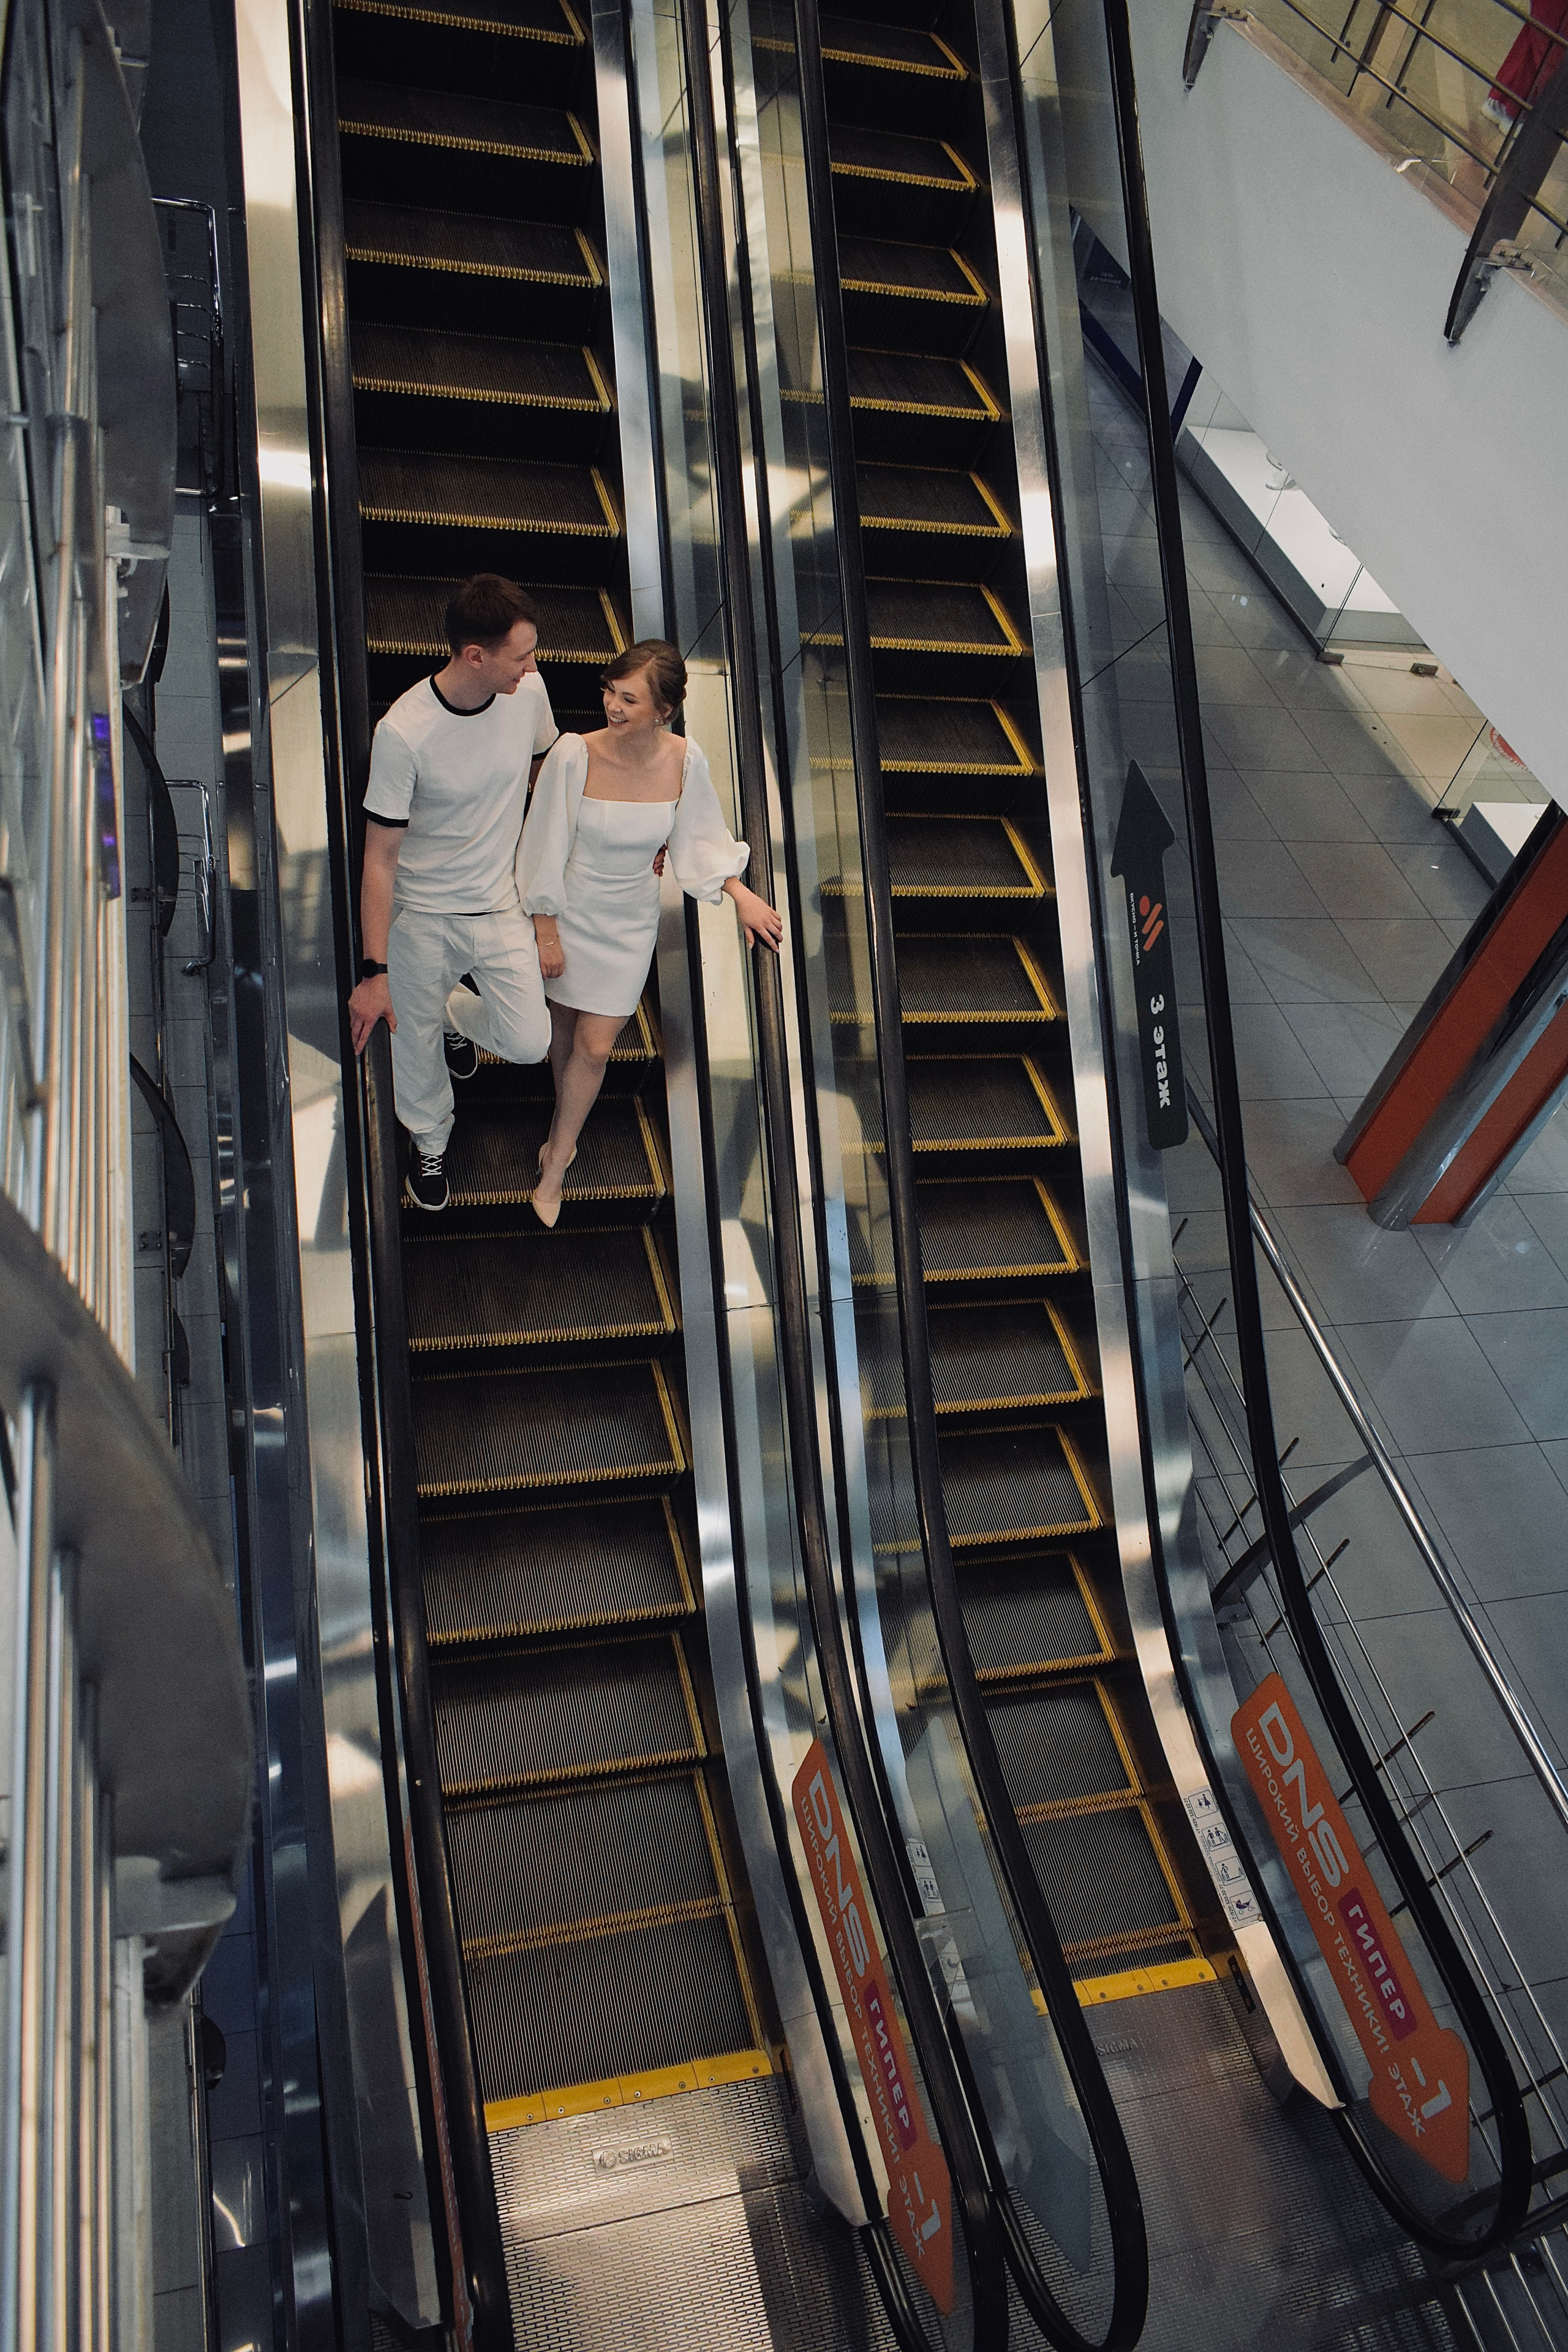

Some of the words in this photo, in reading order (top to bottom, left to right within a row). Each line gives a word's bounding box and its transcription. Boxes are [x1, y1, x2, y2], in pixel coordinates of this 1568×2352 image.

[1151, 994, 1164, 1014] 3
[1153, 1025, 1170, 1109] этаж
[1258, 1701, 1349, 1887] DNS
[809, 1769, 870, 1978] DNS
[1246, 1727, 1300, 1843] ШИРОКИЙ
[1296, 1847, 1335, 1926] ВЫБОР
[1334, 1931, 1390, 2054] ТЕХНИКИ!
[801, 1796, 837, 1924] ШИРОКИЙ
[835, 1930, 862, 2019] ВЫБОР
[861, 2026, 900, 2163] ТЕХНИКИ!
[1348, 1904, 1406, 2019] ГИПЕР
[870, 1997, 910, 2129] ГИПЕР
[1096, 2038, 1139, 2056] SIGMA
[1388, 2062, 1425, 2138] ЭТАЖ
[619, 2142, 666, 2164] SIGMA
[899, 2174, 925, 2259] ЭТАЖ
